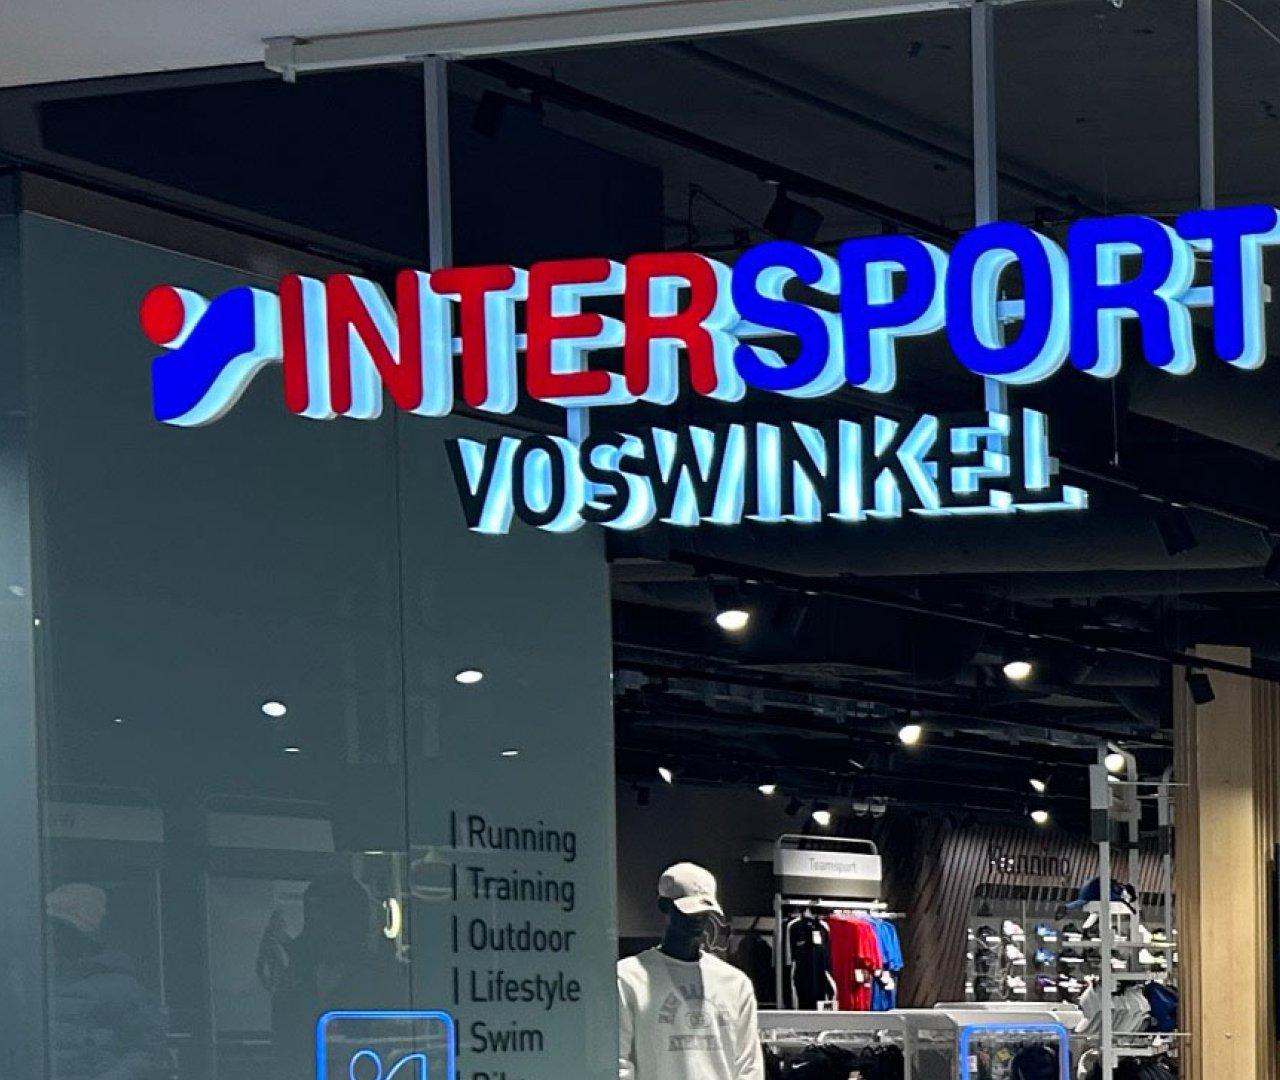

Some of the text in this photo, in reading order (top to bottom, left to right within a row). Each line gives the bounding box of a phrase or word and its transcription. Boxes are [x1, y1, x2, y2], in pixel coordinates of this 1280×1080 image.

[445, 409, 1089, 534] VOSWINKEL
[467, 814, 577, 863] Running
[467, 866, 576, 913] Training
[469, 918, 577, 953] Outdoor
[470, 969, 582, 1011] Lifestyle
[470, 1020, 544, 1053] Swim
